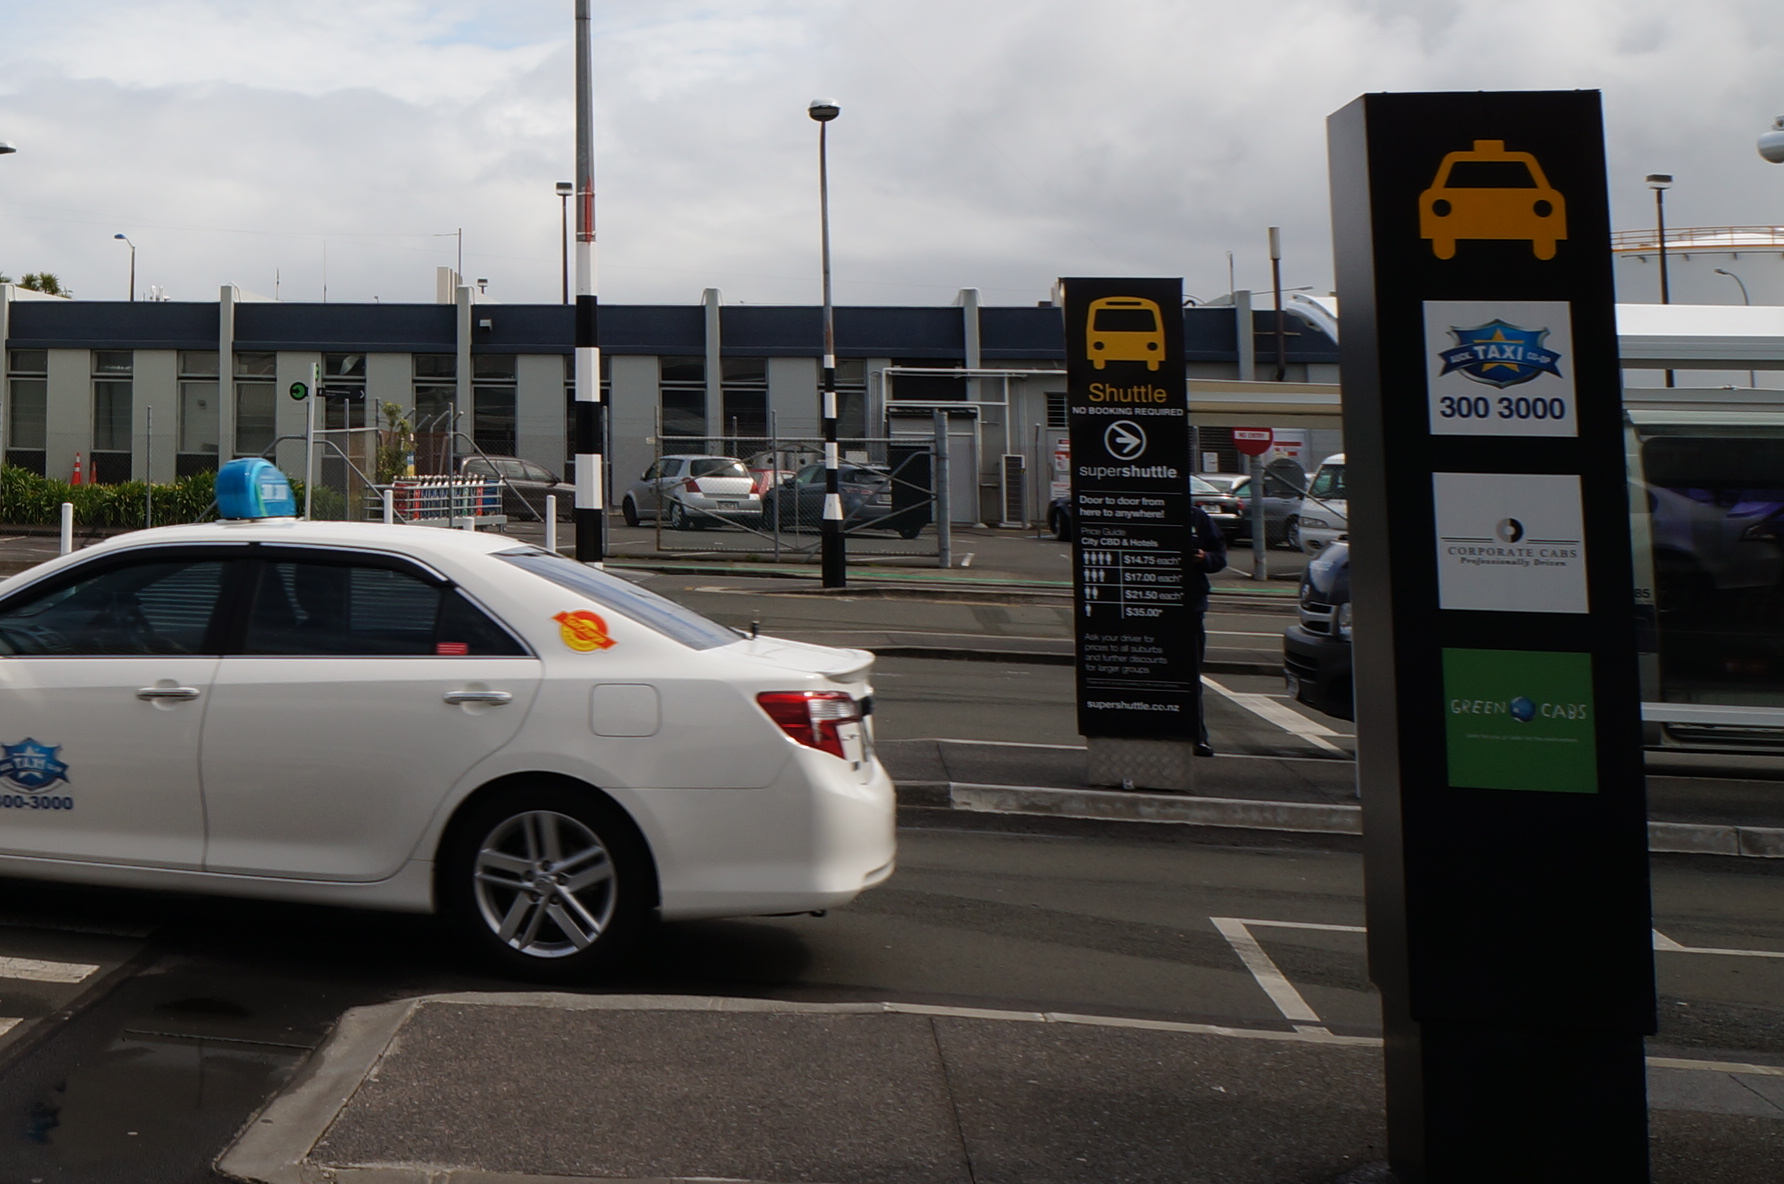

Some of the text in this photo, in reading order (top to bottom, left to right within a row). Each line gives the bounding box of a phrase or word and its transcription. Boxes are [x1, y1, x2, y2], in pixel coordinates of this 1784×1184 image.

[1472, 344, 1524, 360] TAXI
[1088, 382, 1167, 404] Shuttle
[1072, 406, 1184, 417] NO BOOKING REQUIRED
[1439, 396, 1565, 420] 300 3000
[1079, 464, 1178, 480] supershuttle
[1079, 495, 1165, 506] Door to door from
[1079, 507, 1102, 516] here
[1103, 508, 1113, 517] to
[1081, 527, 1126, 536] Price Guide
[1081, 537, 1159, 548] City CBD & Hotels
[1447, 546, 1577, 559] CORPORATE CABS
[1123, 554, 1155, 565] $14.75
[1459, 556, 1530, 567] Professionally
[1084, 633, 1100, 641] Ask
[1101, 635, 1118, 643] your
[1084, 654, 1101, 662] and
[1086, 700, 1180, 712] supershuttle.co.nz
[1450, 699, 1587, 720] GREEN CABS
